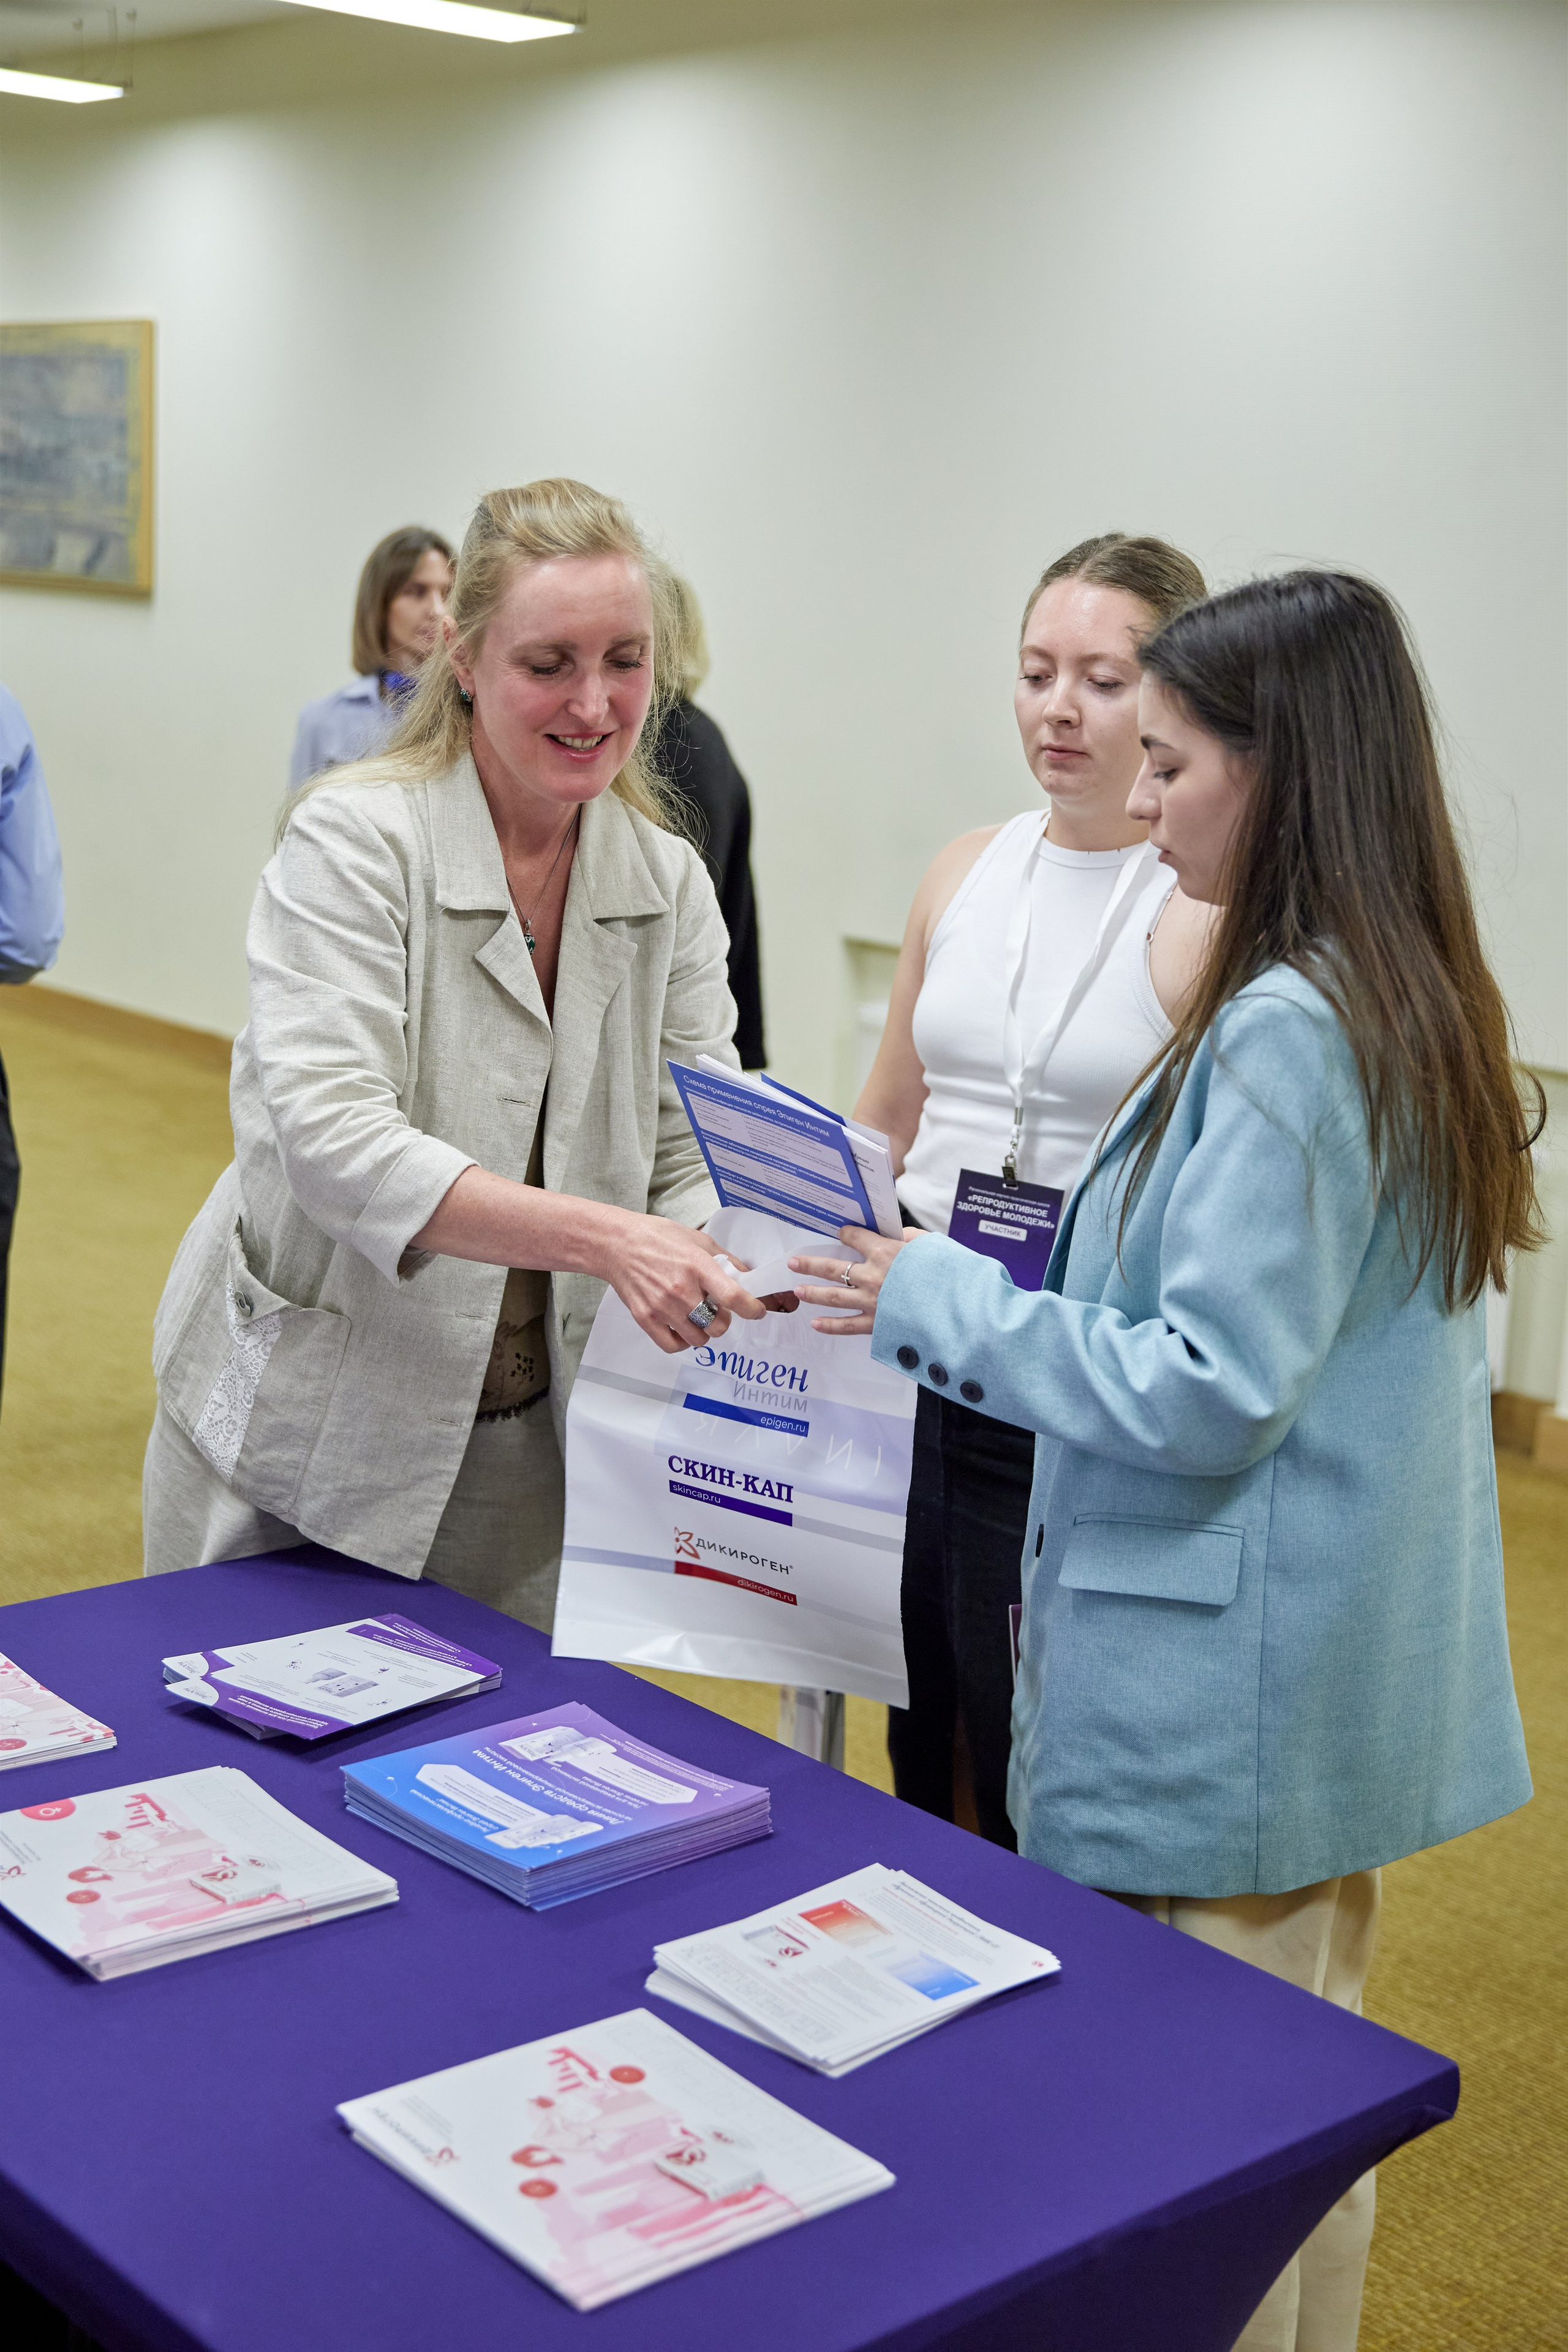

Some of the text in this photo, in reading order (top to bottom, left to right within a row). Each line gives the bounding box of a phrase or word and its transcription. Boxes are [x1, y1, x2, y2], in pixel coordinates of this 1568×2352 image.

[683, 1075, 830, 1137] Схема применения спрея Эпиген Интим
[957, 1201, 1055, 1229] ЗДОРОВЬЕ МОЛОДЕЖИ»
[968, 1194, 1048, 1218] «РЕПРОДУКТИВНОЕ
[985, 1224, 1021, 1237] УЧАСТНИК
[693, 1345, 809, 1392] Эпиген
[733, 1380, 807, 1413] Интим
[760, 1415, 806, 1433] epigen.ru
[668, 1455, 794, 1503] СКИН-КАП
[673, 1483, 721, 1504] skincap.ru
[737, 1578, 794, 1603] dikirogen.ru
[472, 1749, 507, 1771] Интим
[484, 1747, 508, 1762] кислоты
[505, 1770, 545, 1791] Эпиген
[544, 1790, 589, 1811] средств
[587, 1809, 624, 1824] Линия
